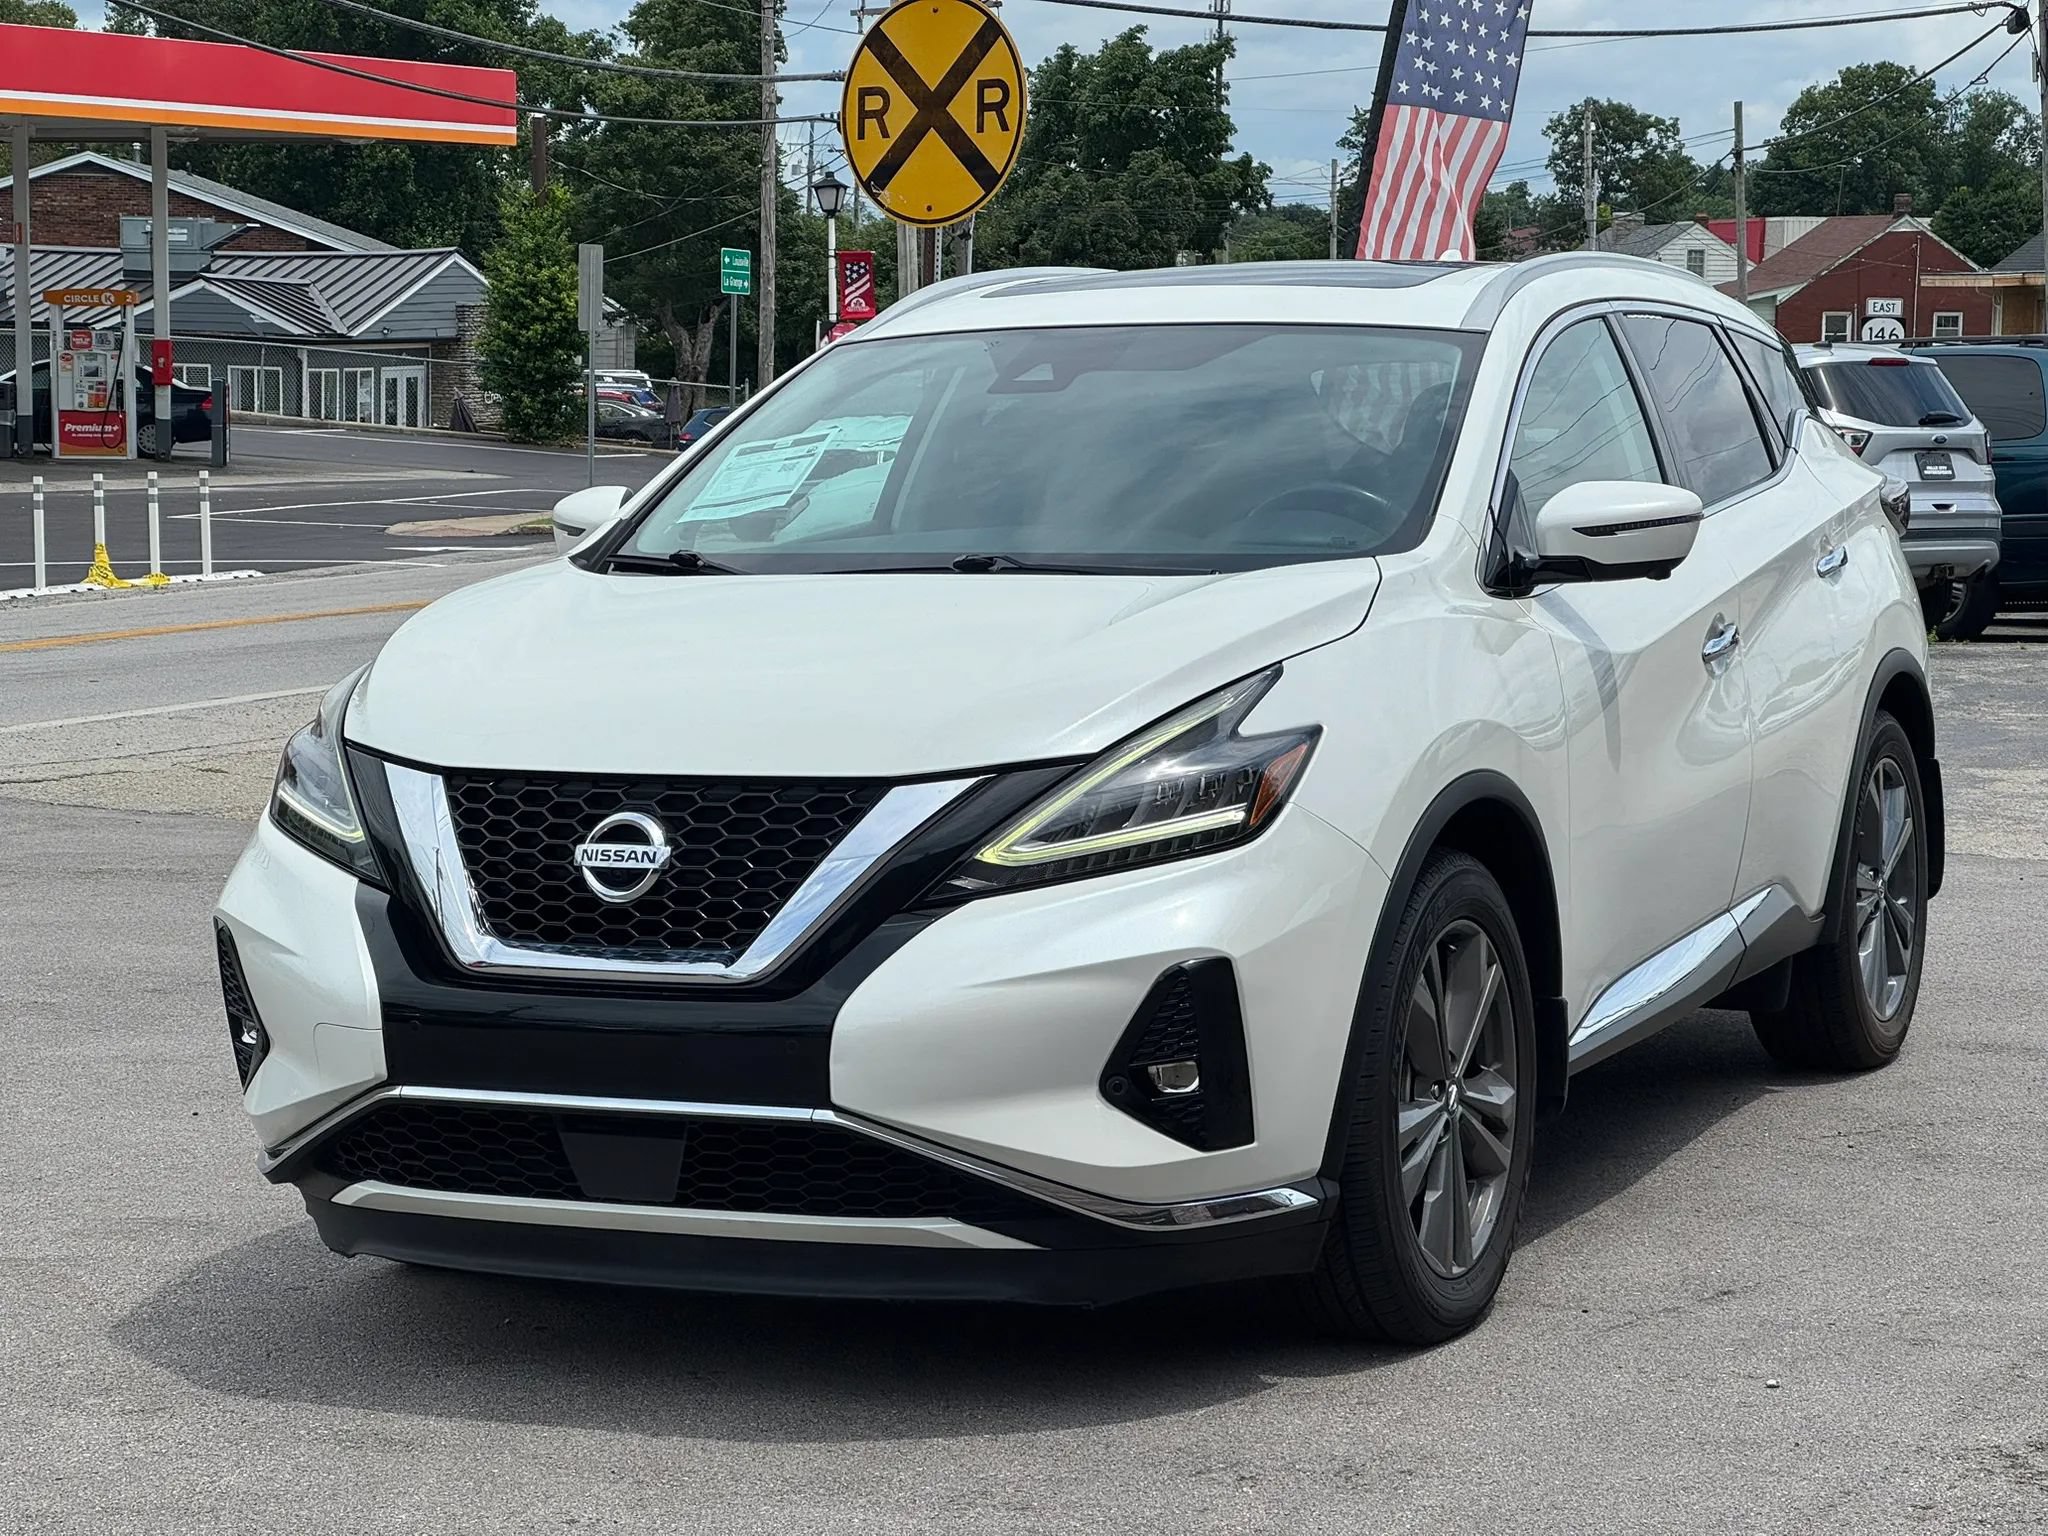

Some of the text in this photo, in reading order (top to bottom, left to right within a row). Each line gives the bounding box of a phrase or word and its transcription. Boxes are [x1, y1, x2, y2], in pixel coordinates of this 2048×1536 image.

[857, 78, 1010, 140] R R
[723, 275, 729, 286] La
[63, 292, 114, 305] CIRCLE K
[125, 294, 133, 303] 2
[1872, 301, 1897, 313] EAST
[1868, 326, 1899, 340] 146
[581, 848, 657, 864] NISSAN
